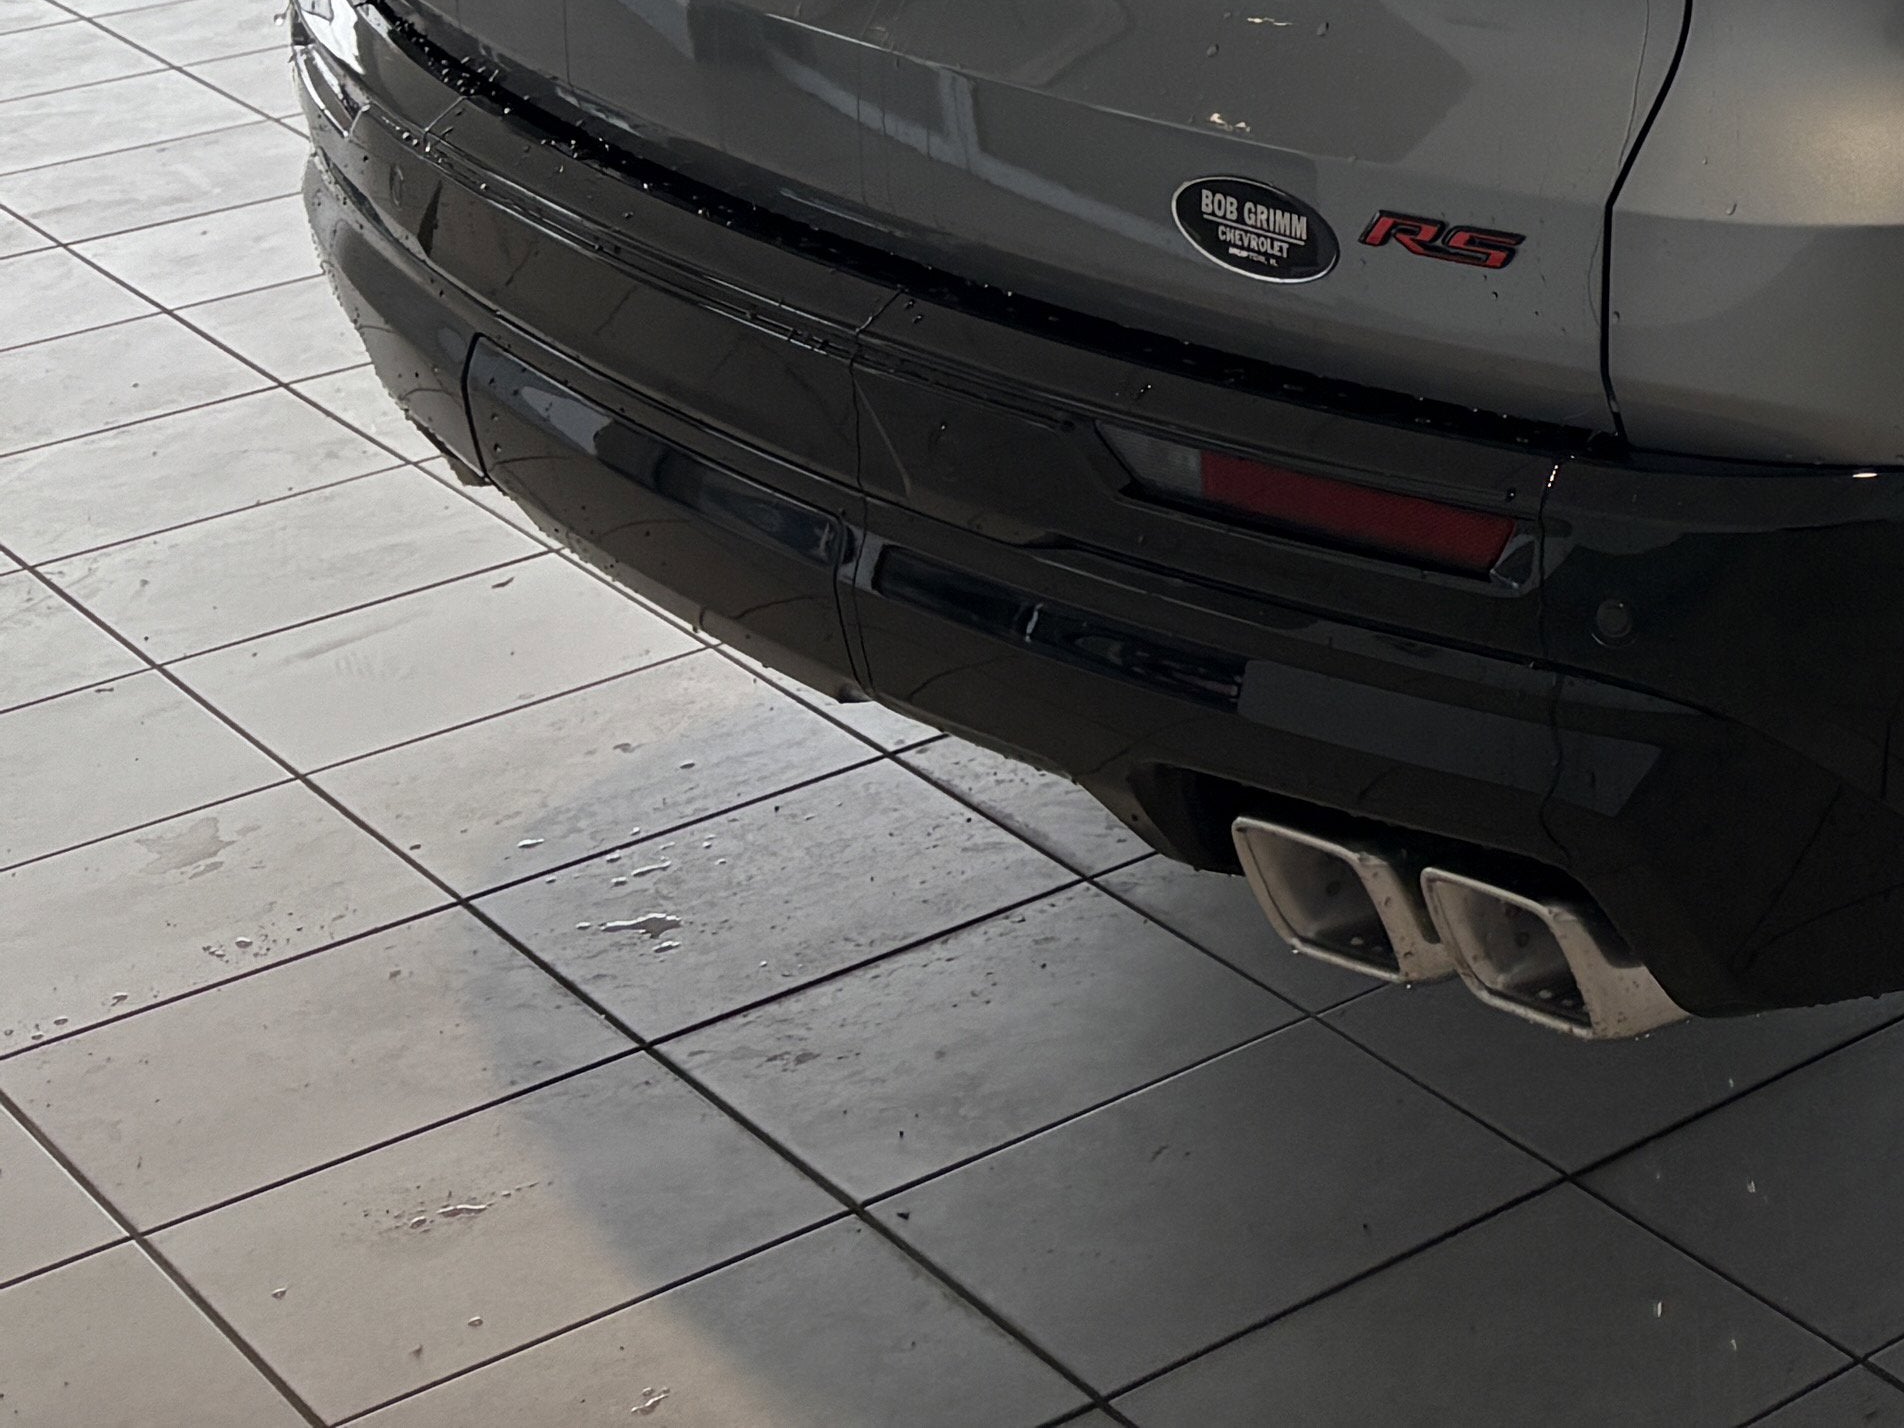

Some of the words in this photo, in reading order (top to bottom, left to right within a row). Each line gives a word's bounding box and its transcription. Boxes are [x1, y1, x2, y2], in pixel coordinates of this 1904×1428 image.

[1201, 189, 1238, 221] BOB
[1243, 201, 1307, 240] GRIMM
[1358, 209, 1527, 270] RS
[1218, 225, 1289, 258] CHEVROLET
